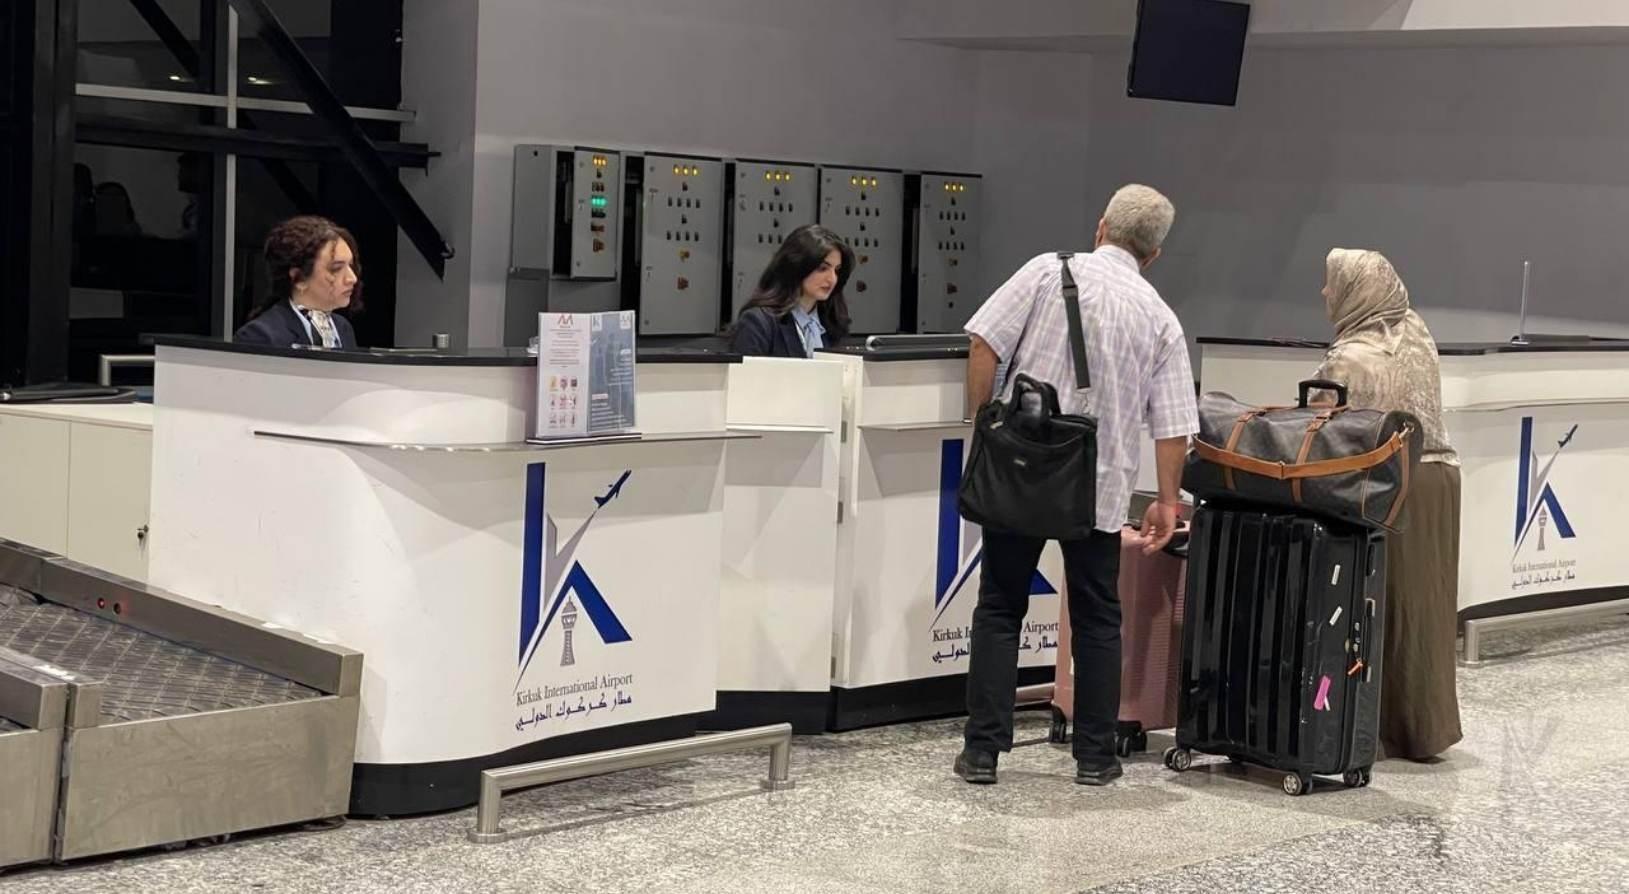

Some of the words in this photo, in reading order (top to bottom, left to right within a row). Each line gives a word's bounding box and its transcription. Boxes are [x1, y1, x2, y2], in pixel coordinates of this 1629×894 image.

[932, 627, 963, 642] Kirkuk
[1023, 620, 1060, 635] Airport
[1034, 635, 1058, 653] مطار
[516, 687, 542, 706] Kirkuk
[544, 676, 598, 700] International
[600, 673, 633, 690] Airport
[555, 692, 608, 720] كركوك
[610, 690, 633, 713] مطار
[515, 703, 553, 732] الدولي
